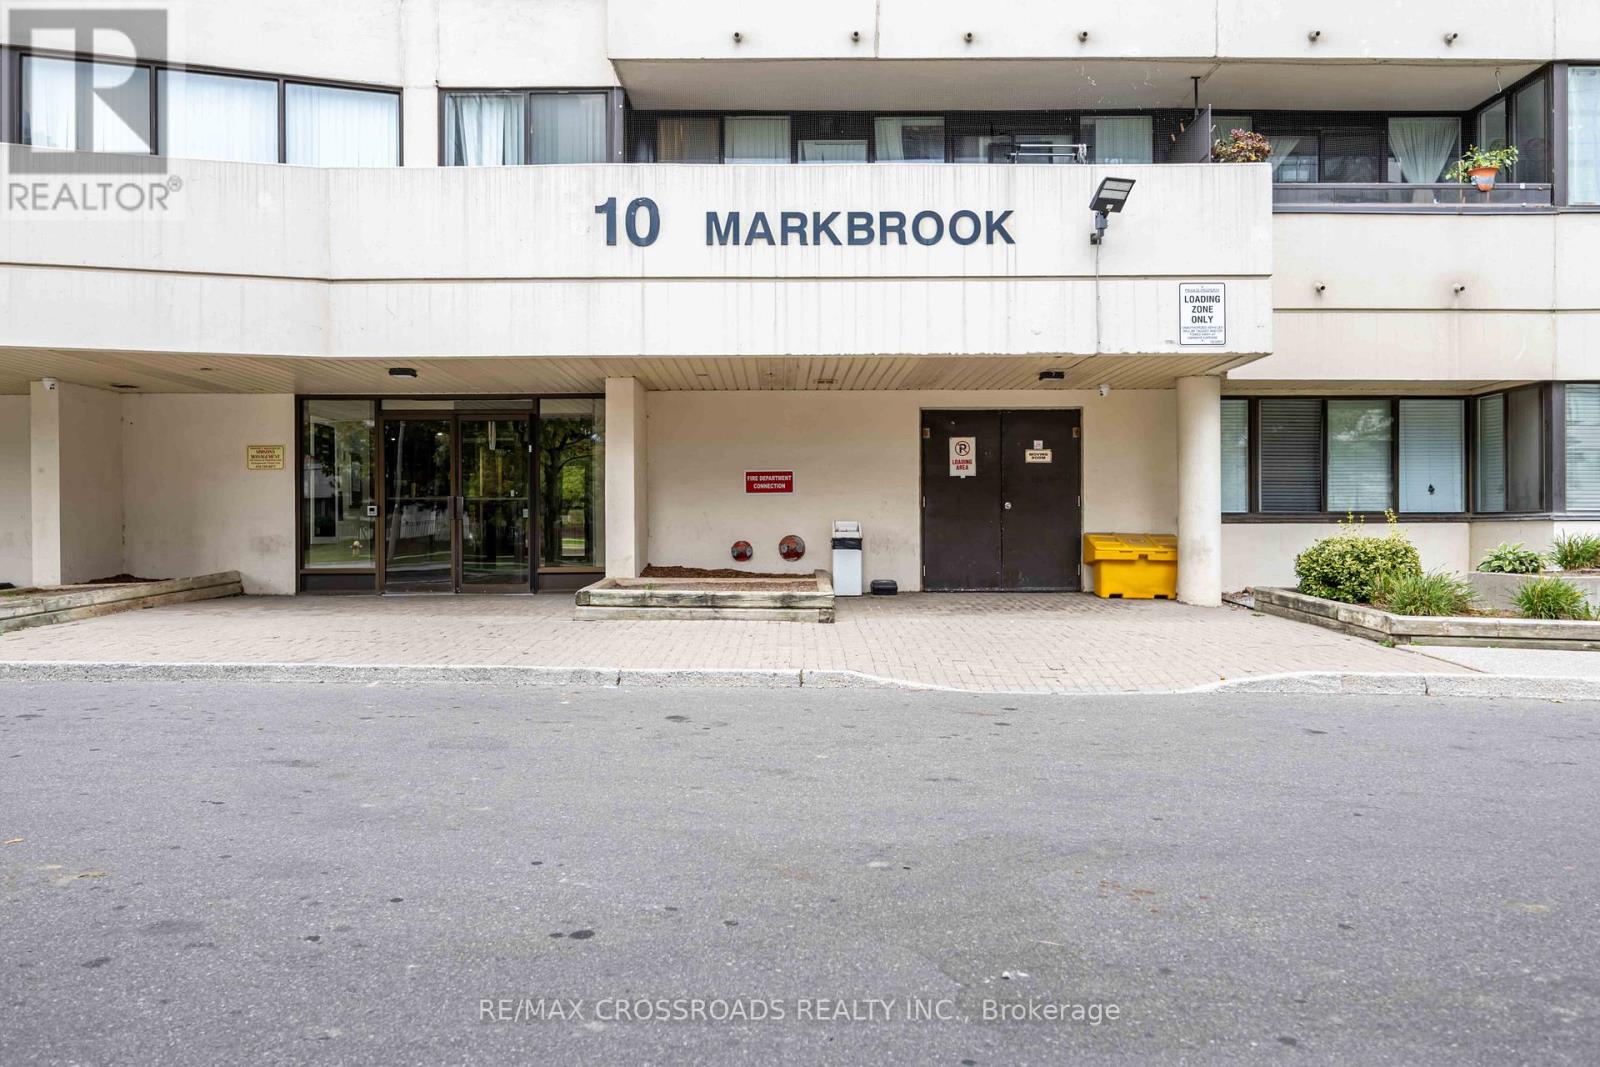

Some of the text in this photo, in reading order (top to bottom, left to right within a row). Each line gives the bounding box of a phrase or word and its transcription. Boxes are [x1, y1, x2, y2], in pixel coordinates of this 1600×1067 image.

[594, 197, 1016, 248] 10 MARKBROOK
[1184, 295, 1221, 303] LOADING
[1191, 305, 1214, 313] ZONE
[1191, 315, 1214, 324] ONLY
